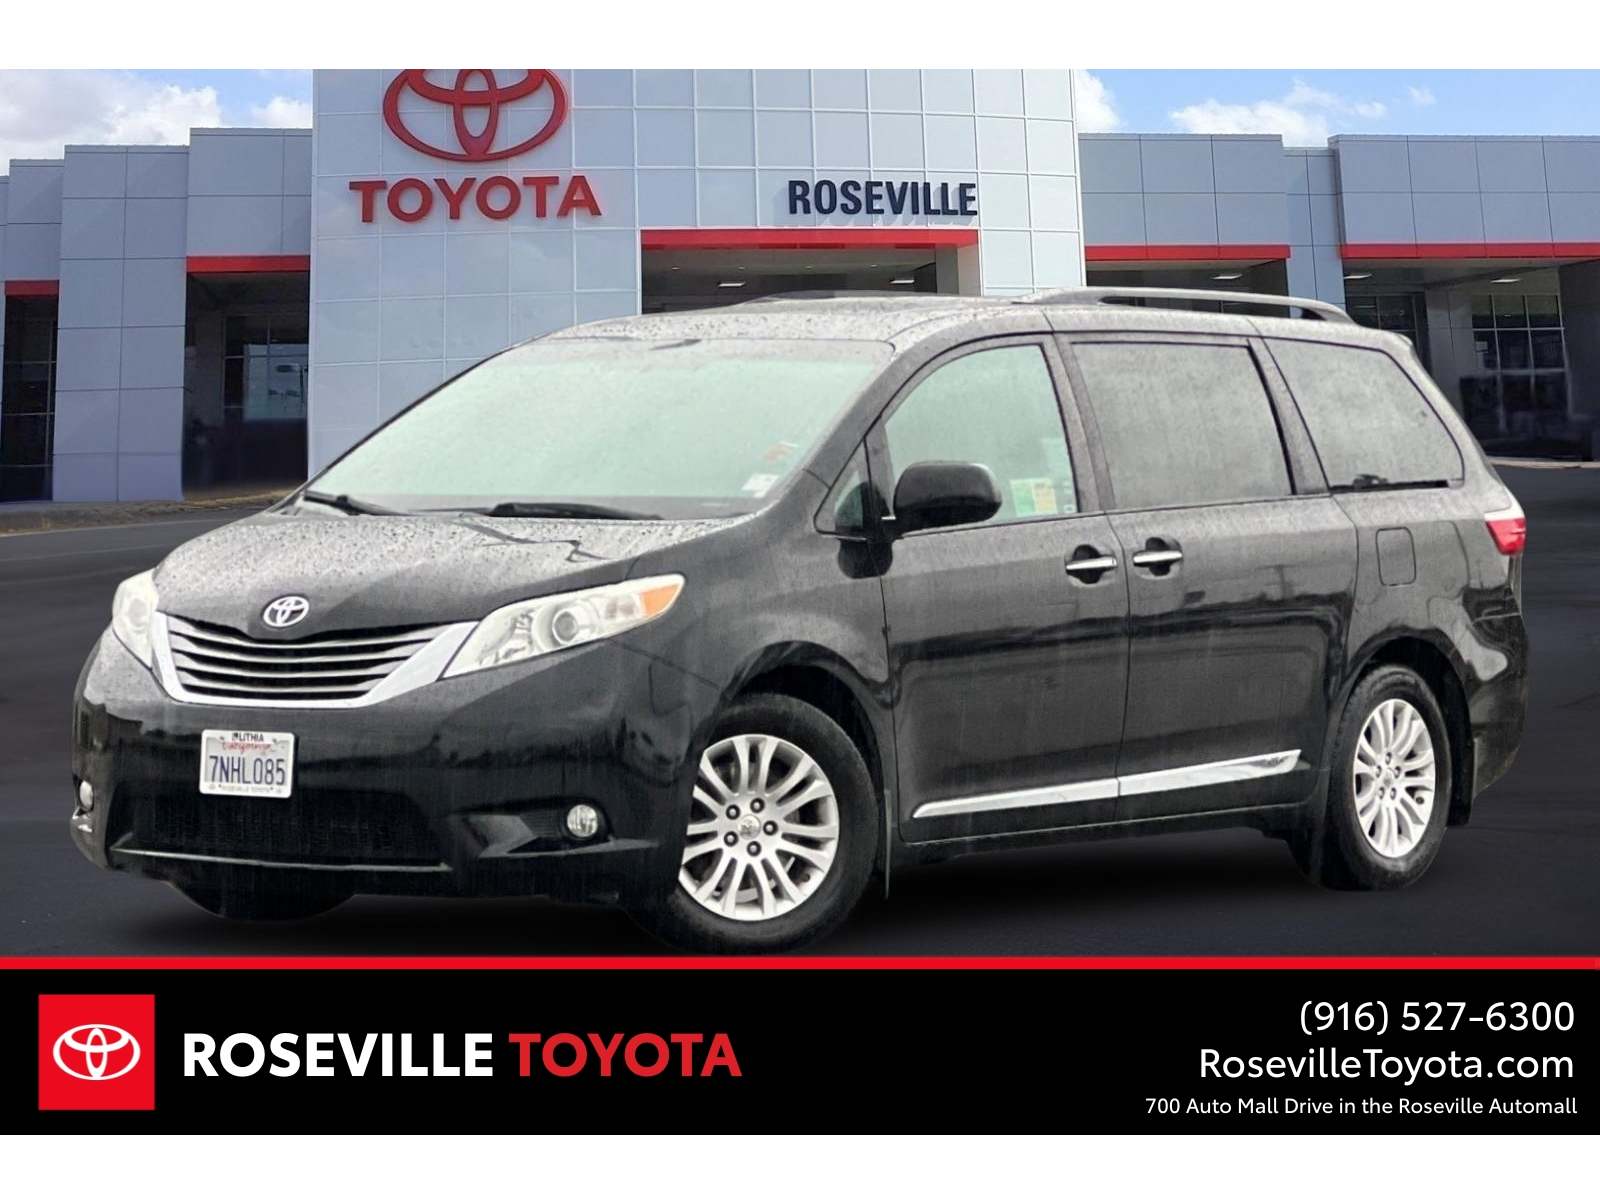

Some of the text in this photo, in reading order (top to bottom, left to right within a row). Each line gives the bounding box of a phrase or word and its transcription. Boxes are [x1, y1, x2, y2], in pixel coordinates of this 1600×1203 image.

[349, 175, 602, 223] TOYOTA
[788, 179, 979, 217] ROSEVILLE
[239, 733, 265, 742] LITHIA
[209, 755, 286, 786] 7NHL085
